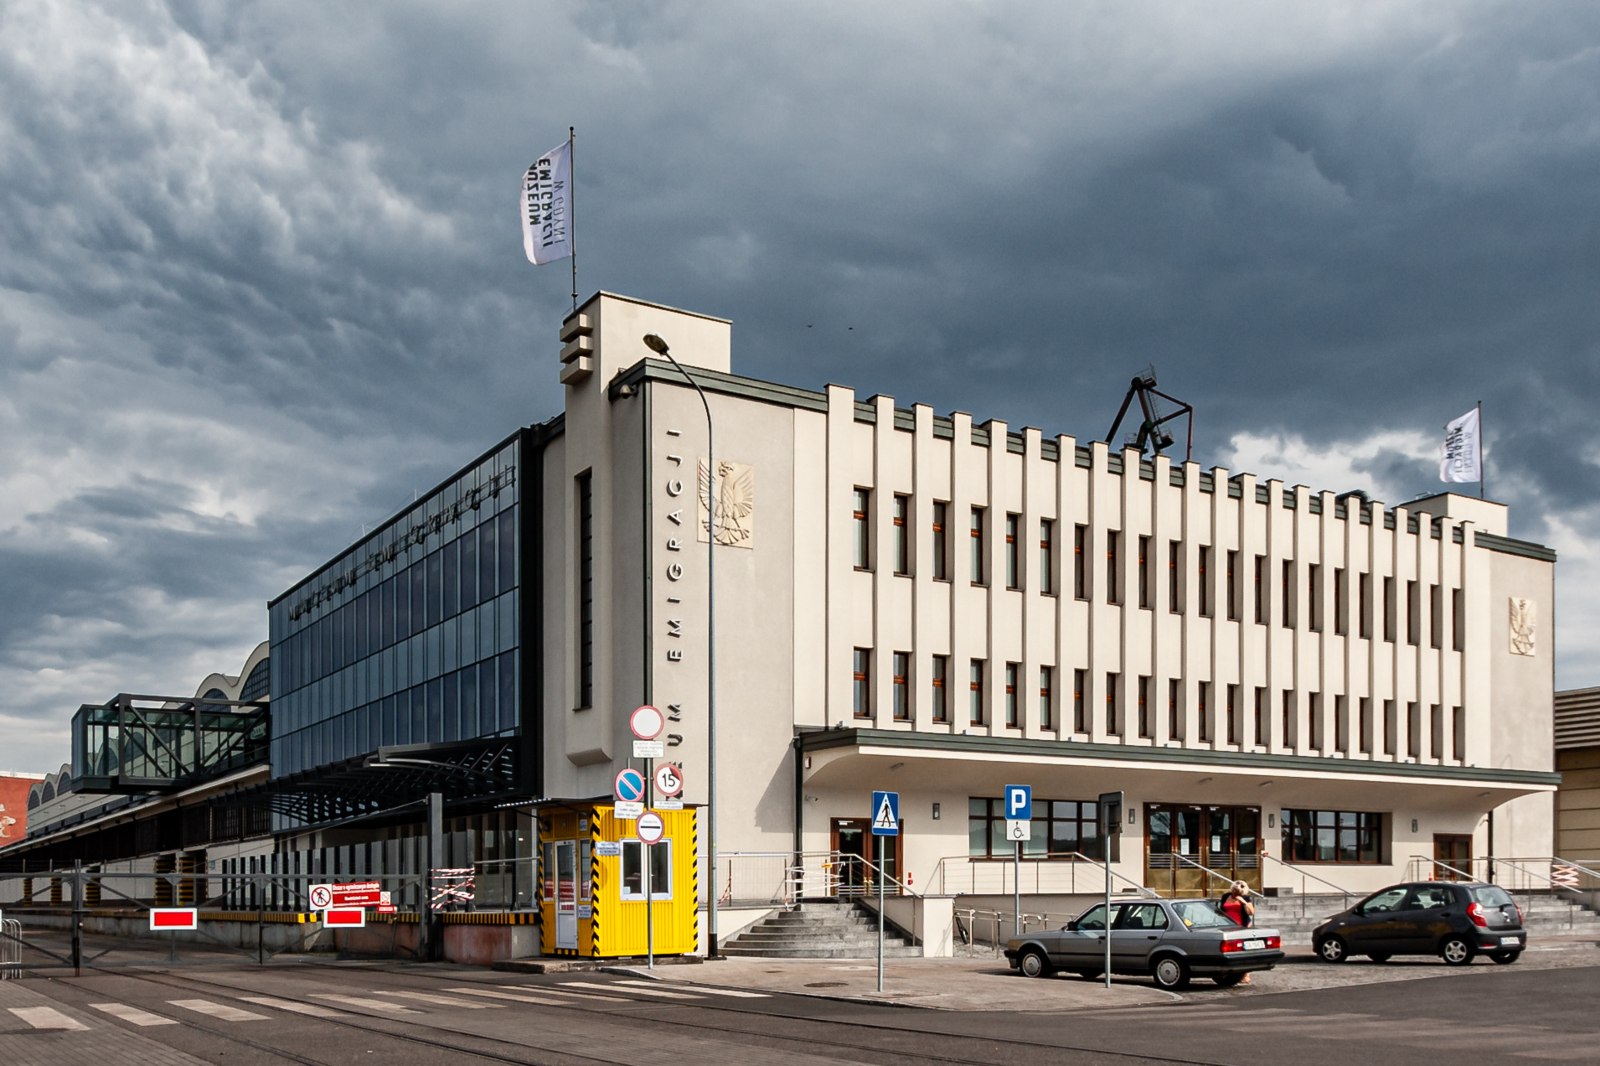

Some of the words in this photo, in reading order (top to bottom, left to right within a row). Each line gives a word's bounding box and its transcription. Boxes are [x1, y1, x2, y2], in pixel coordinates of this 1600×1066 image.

[666, 429, 684, 663] EMIGRACJI
[662, 774, 676, 787] 15
[1011, 789, 1026, 815] P
